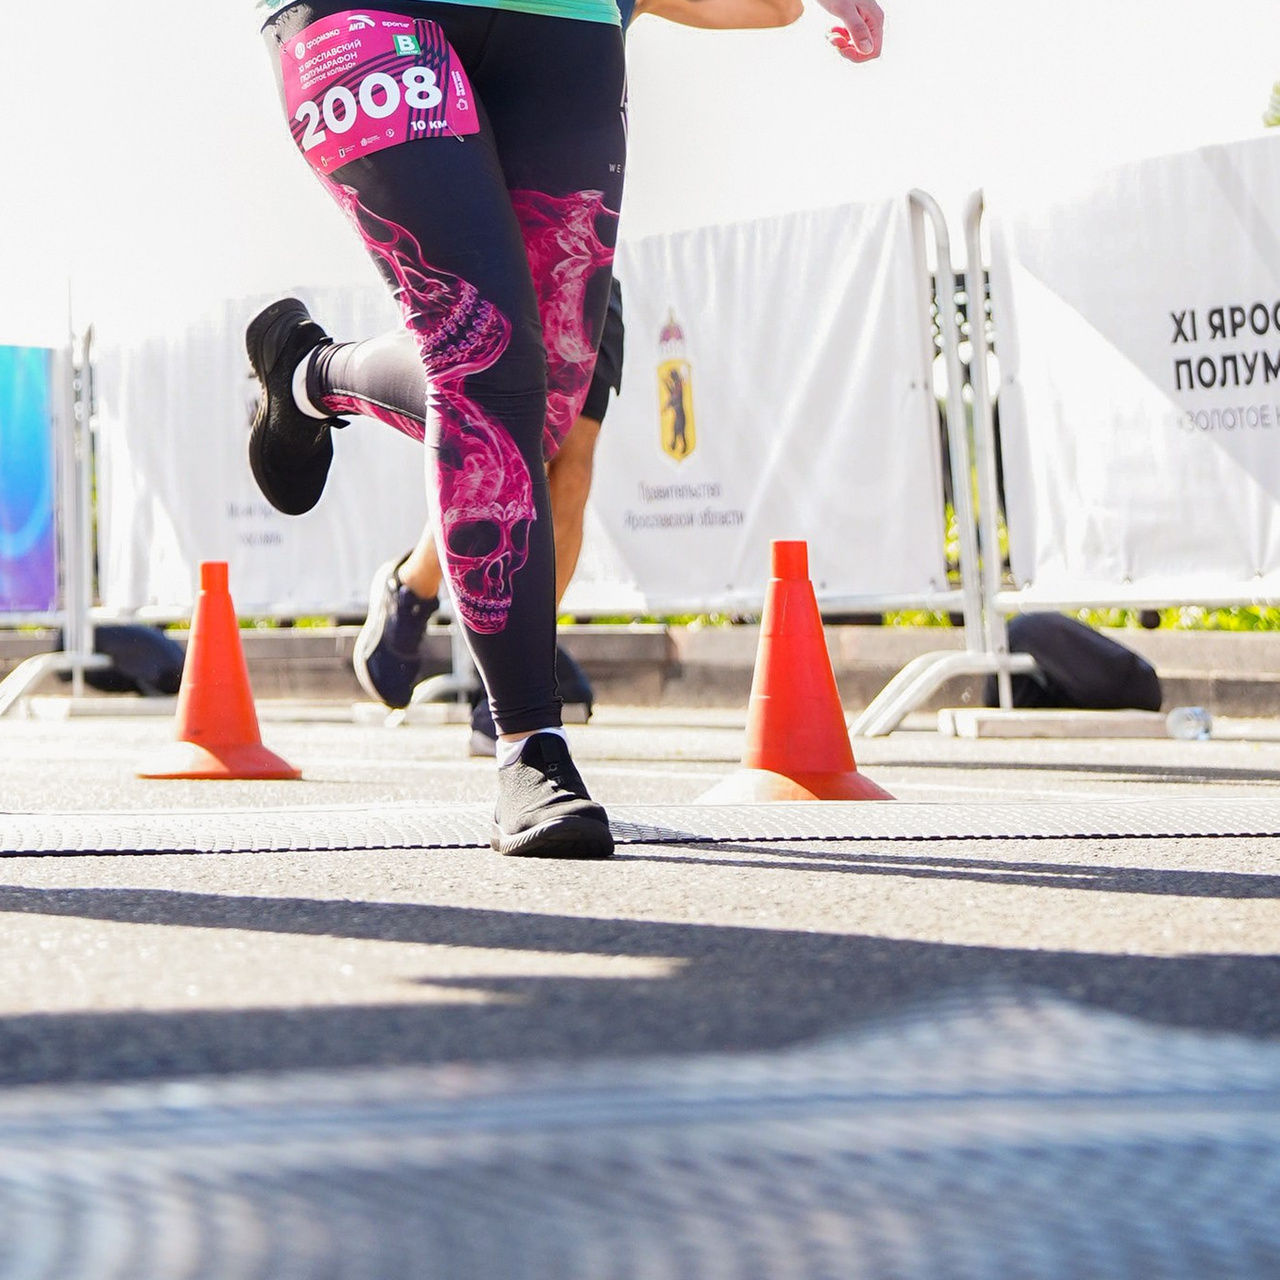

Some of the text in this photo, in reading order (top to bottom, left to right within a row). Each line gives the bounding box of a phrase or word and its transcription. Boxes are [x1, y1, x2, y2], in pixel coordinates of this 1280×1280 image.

[300, 52, 357, 83] ПОЛУМАРАФОН
[304, 39, 362, 69] ЯРОСЛАВСКИЙ
[294, 66, 443, 152] 2008
[411, 120, 427, 131] 10
